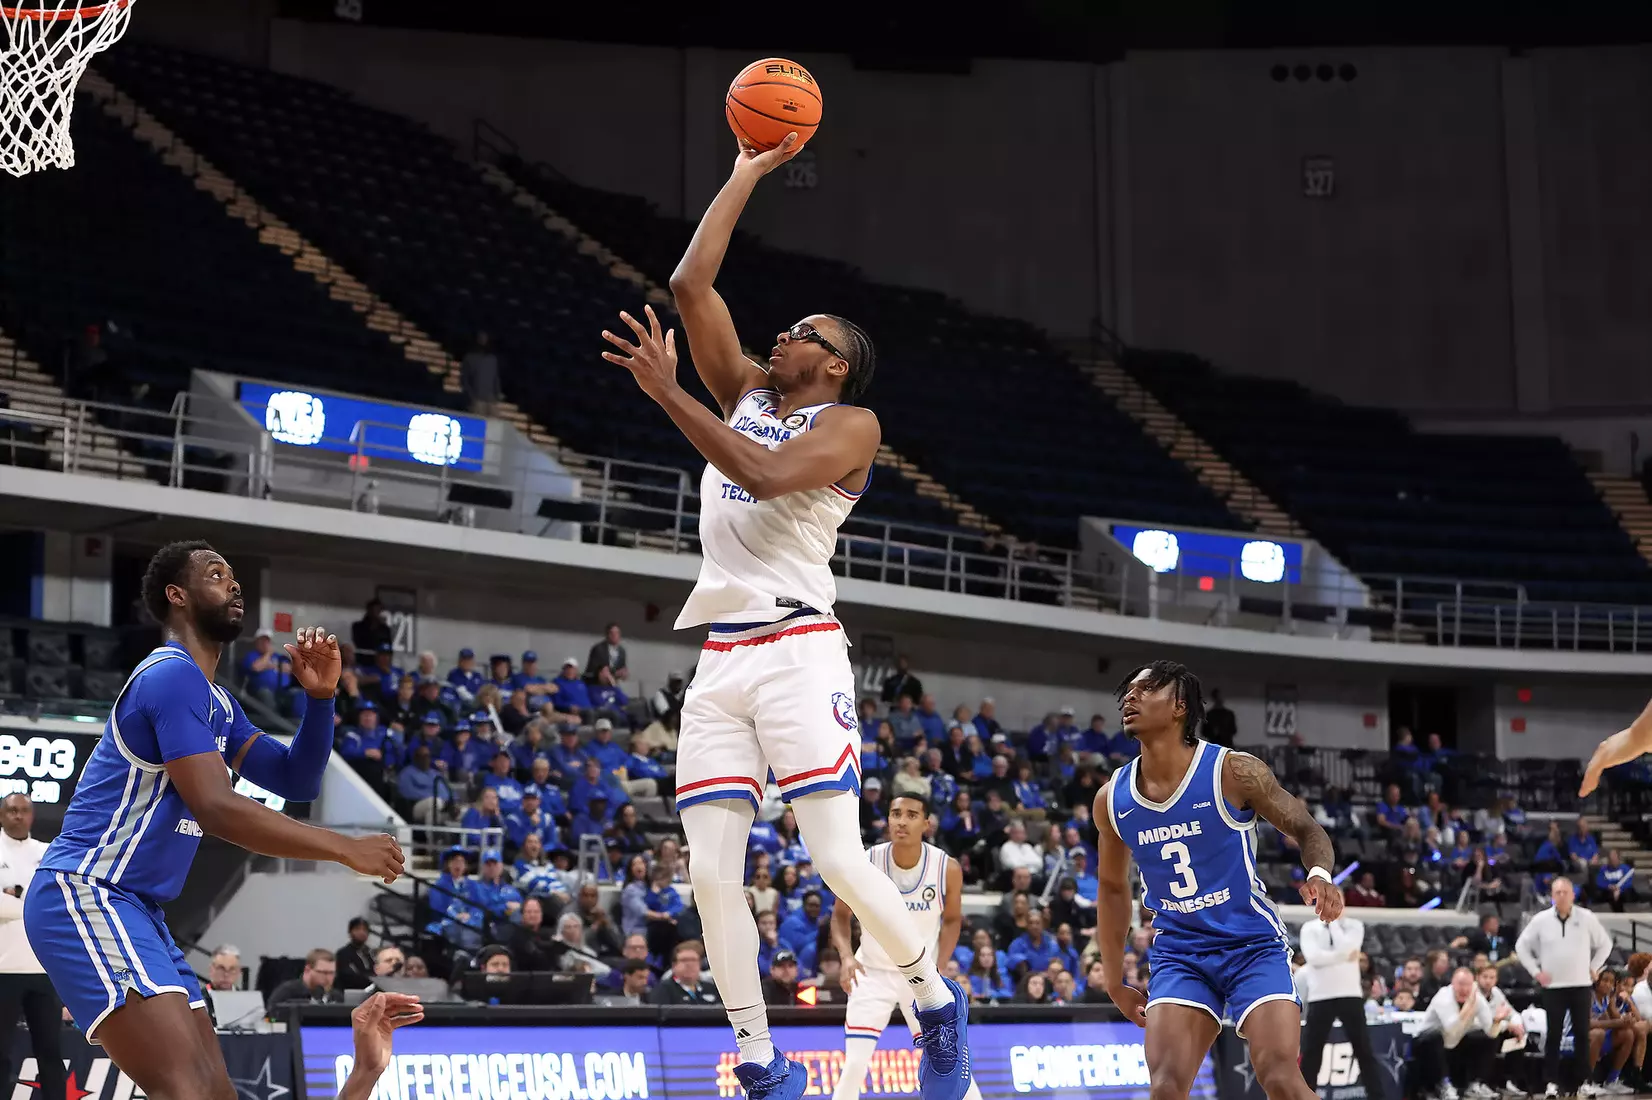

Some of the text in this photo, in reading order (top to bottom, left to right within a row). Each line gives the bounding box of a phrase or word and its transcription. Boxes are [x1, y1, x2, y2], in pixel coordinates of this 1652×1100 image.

[1138, 821, 1202, 845] MIDDLE
[1160, 841, 1199, 899] 3
[334, 1052, 649, 1100] CNFERENCEUSA.COM
[1010, 1043, 1152, 1093] @CONFERENC
